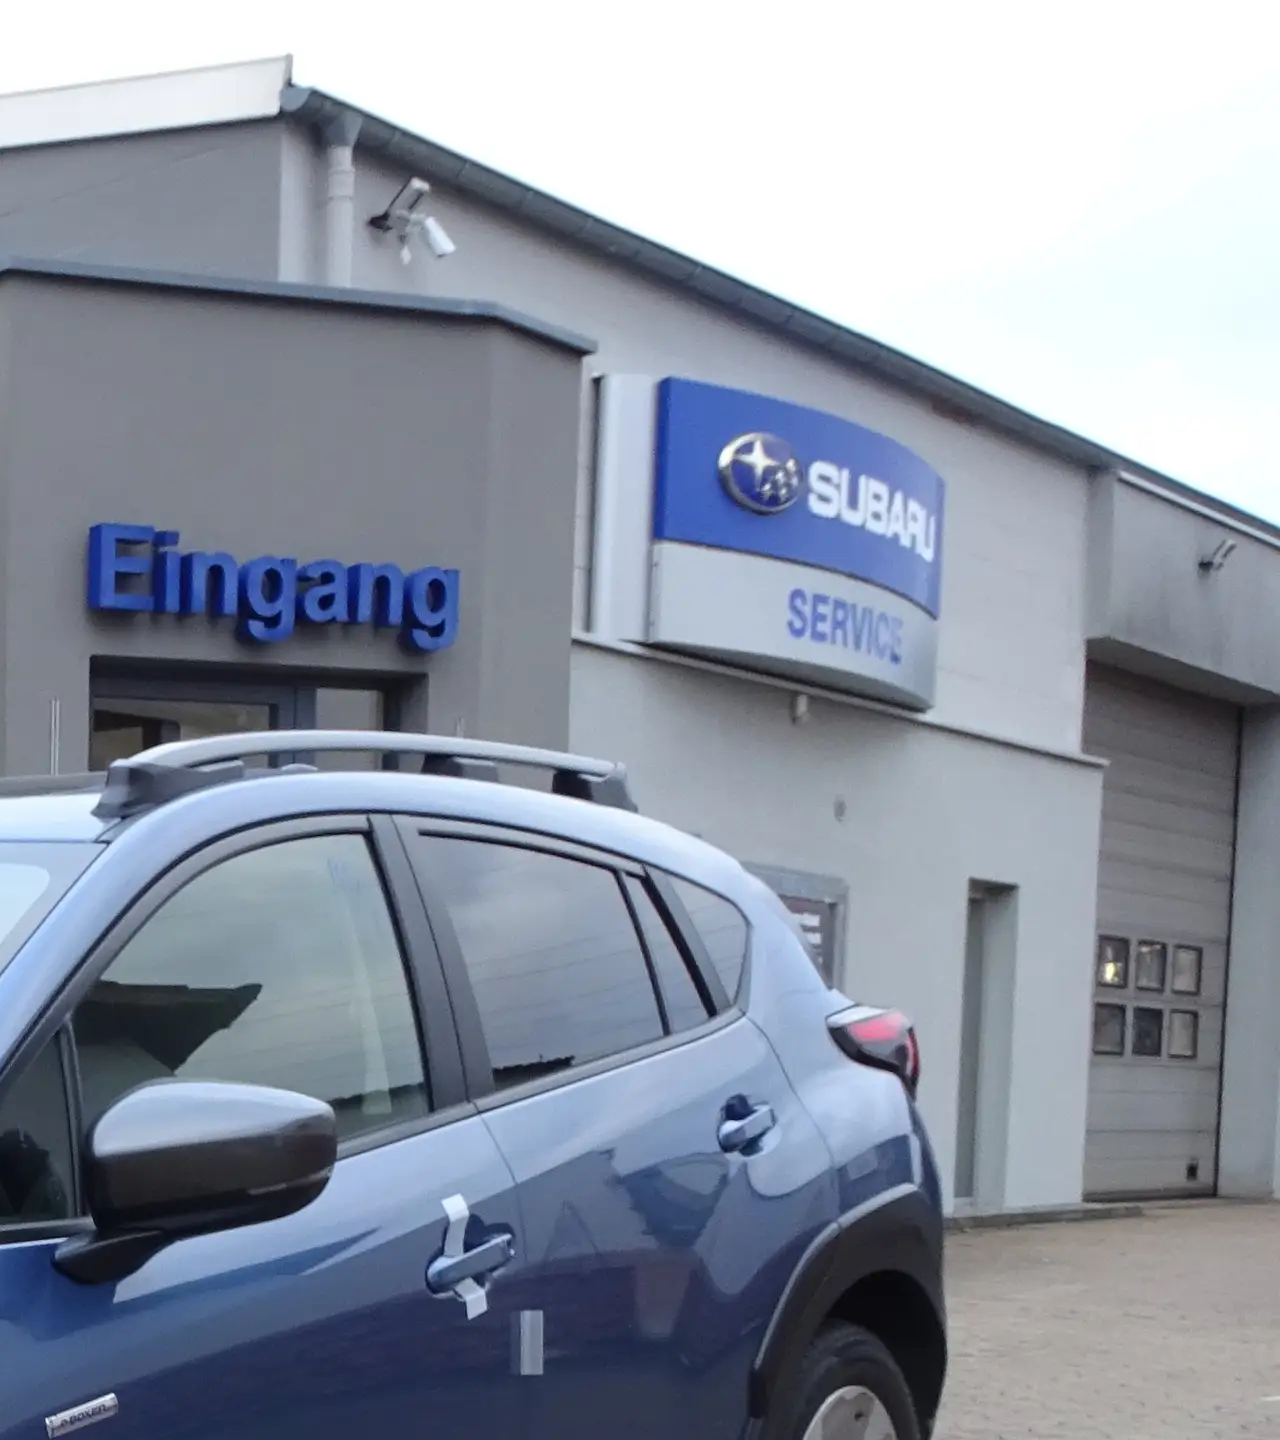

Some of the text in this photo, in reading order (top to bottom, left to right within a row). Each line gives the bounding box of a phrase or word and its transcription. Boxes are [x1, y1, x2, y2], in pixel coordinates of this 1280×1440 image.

[807, 460, 935, 562] SUBARU
[88, 522, 460, 652] Eingang
[787, 588, 903, 665] SERVICE
